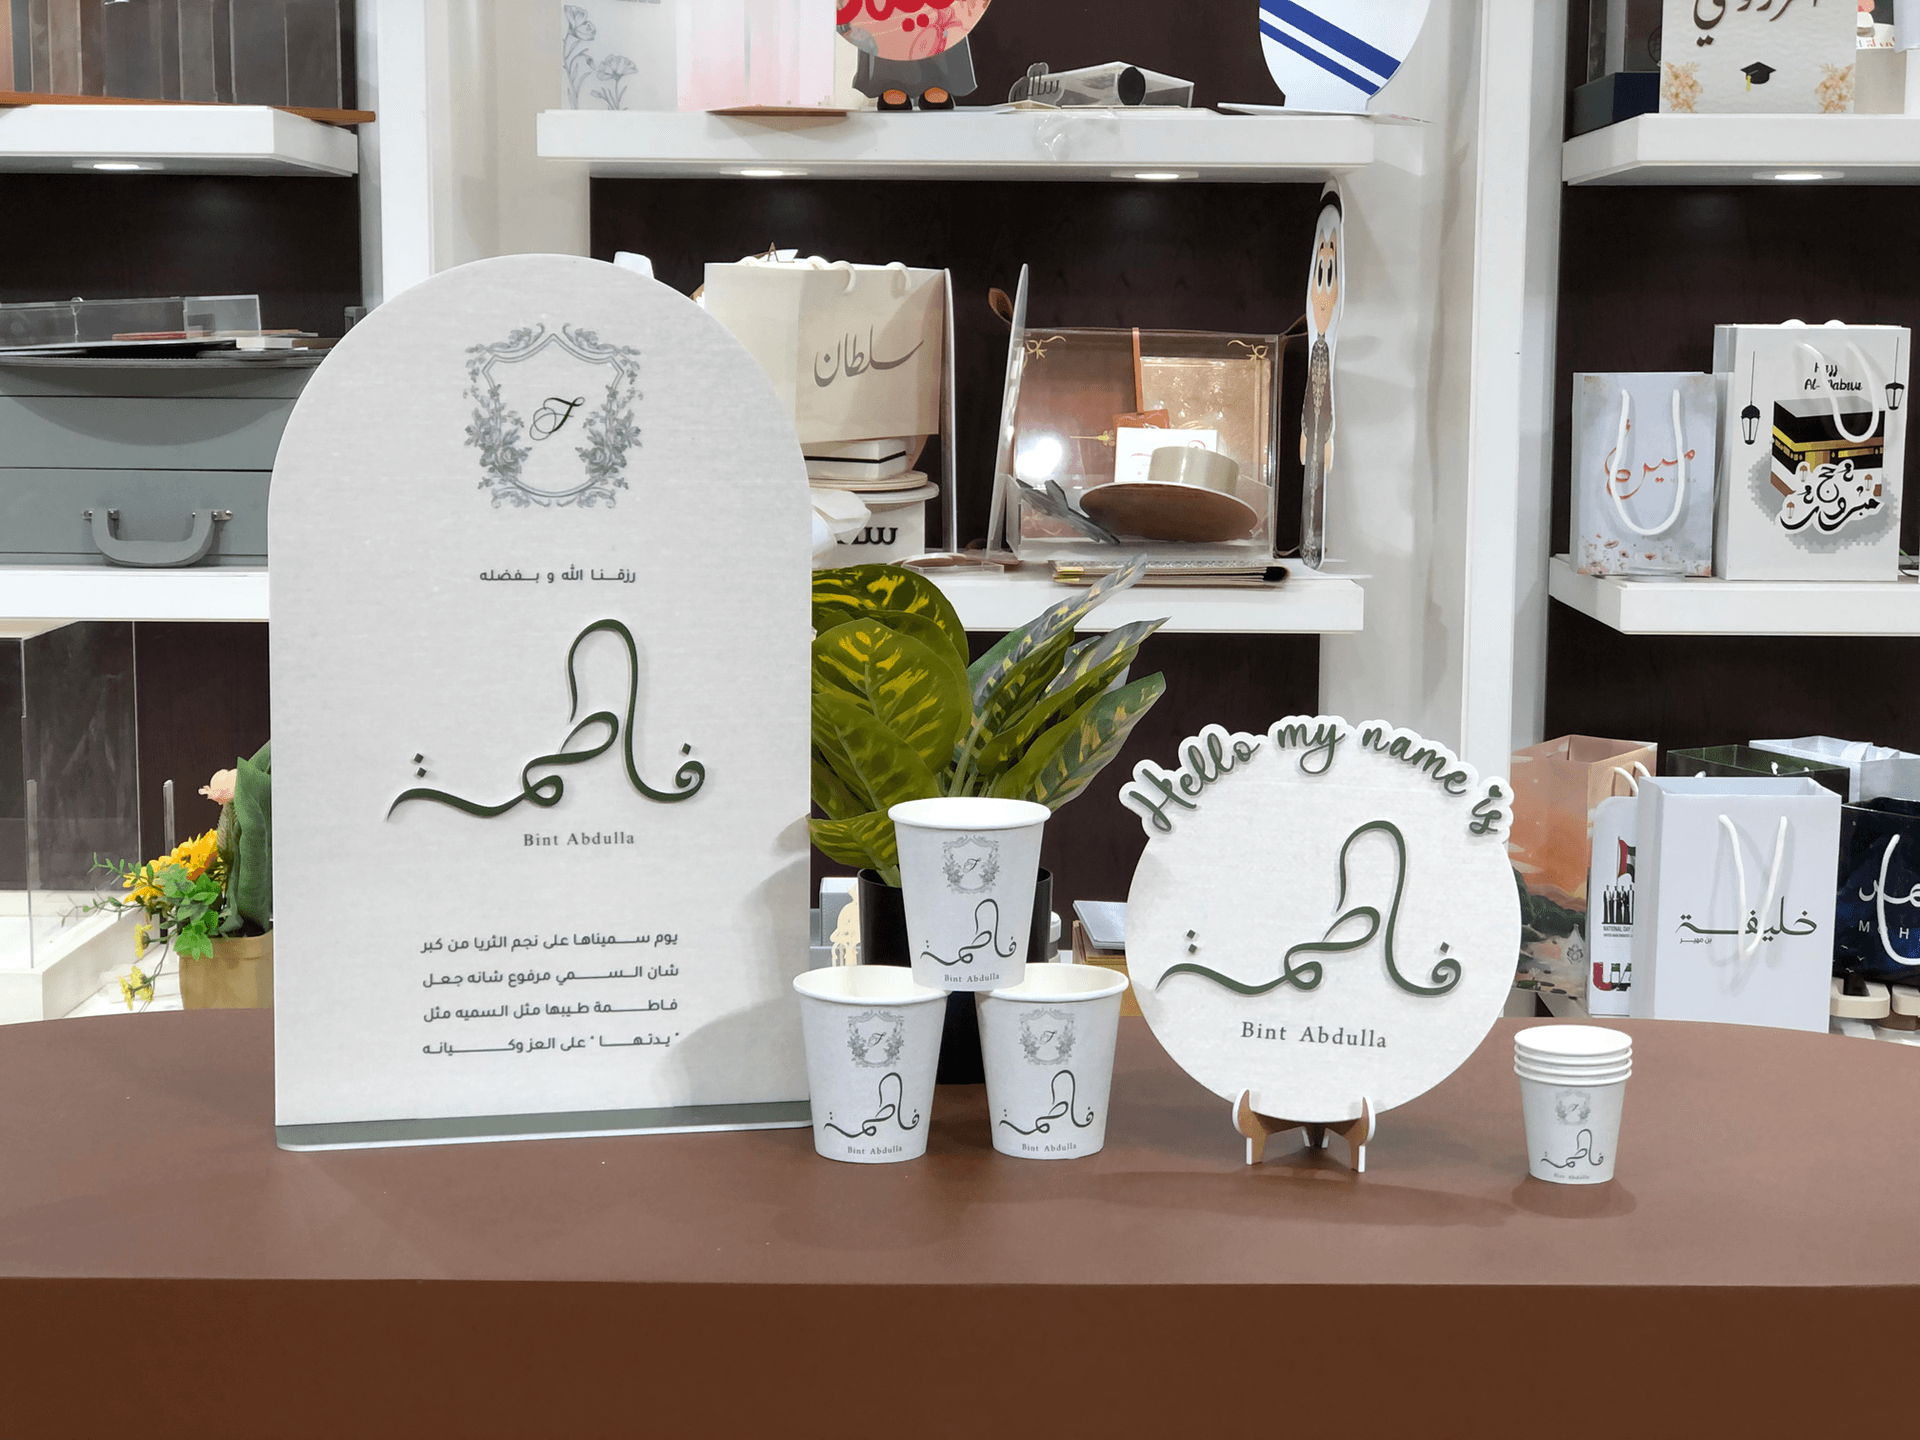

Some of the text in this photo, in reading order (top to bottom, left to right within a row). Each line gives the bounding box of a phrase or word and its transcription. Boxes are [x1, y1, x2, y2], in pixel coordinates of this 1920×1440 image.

[813, 324, 925, 388] سلطان
[479, 563, 636, 584] رزقنا الله و بفضله
[1128, 722, 1504, 836] Hello my name is
[523, 831, 636, 847] Bint Abdulla
[1674, 895, 1818, 942] خليفة
[419, 932, 678, 954] يوم سميناها على نجم الثريا من كبر
[422, 963, 679, 988] شان السمي مرفوع شانه جعل
[943, 971, 1001, 983] Bint Abdulla
[423, 998, 678, 1023] فاطمة طيبها مثل السميه مثل
[525, 1037, 556, 1053] العز
[560, 1036, 586, 1052] على
[1240, 1020, 1387, 1049] Bint Abdulla
[847, 1144, 903, 1156] Bint Abdulla
[1021, 1142, 1077, 1153] Bint Abdulla
